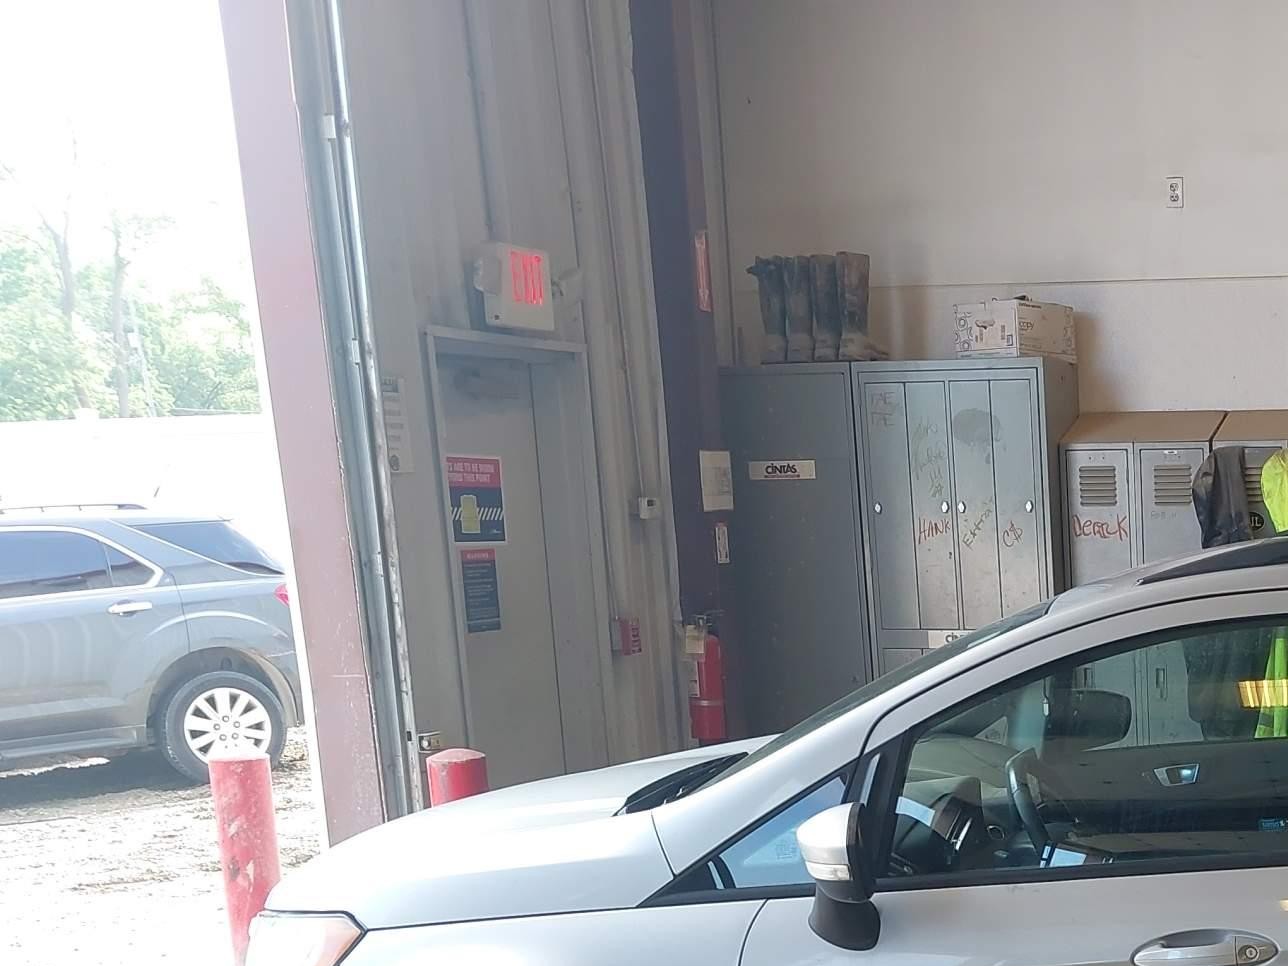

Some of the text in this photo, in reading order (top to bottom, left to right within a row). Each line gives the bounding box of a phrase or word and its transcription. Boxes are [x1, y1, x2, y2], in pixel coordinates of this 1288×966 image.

[511, 251, 544, 304] EXIT
[765, 463, 798, 475] CINTAS
[918, 516, 951, 545] HANK
